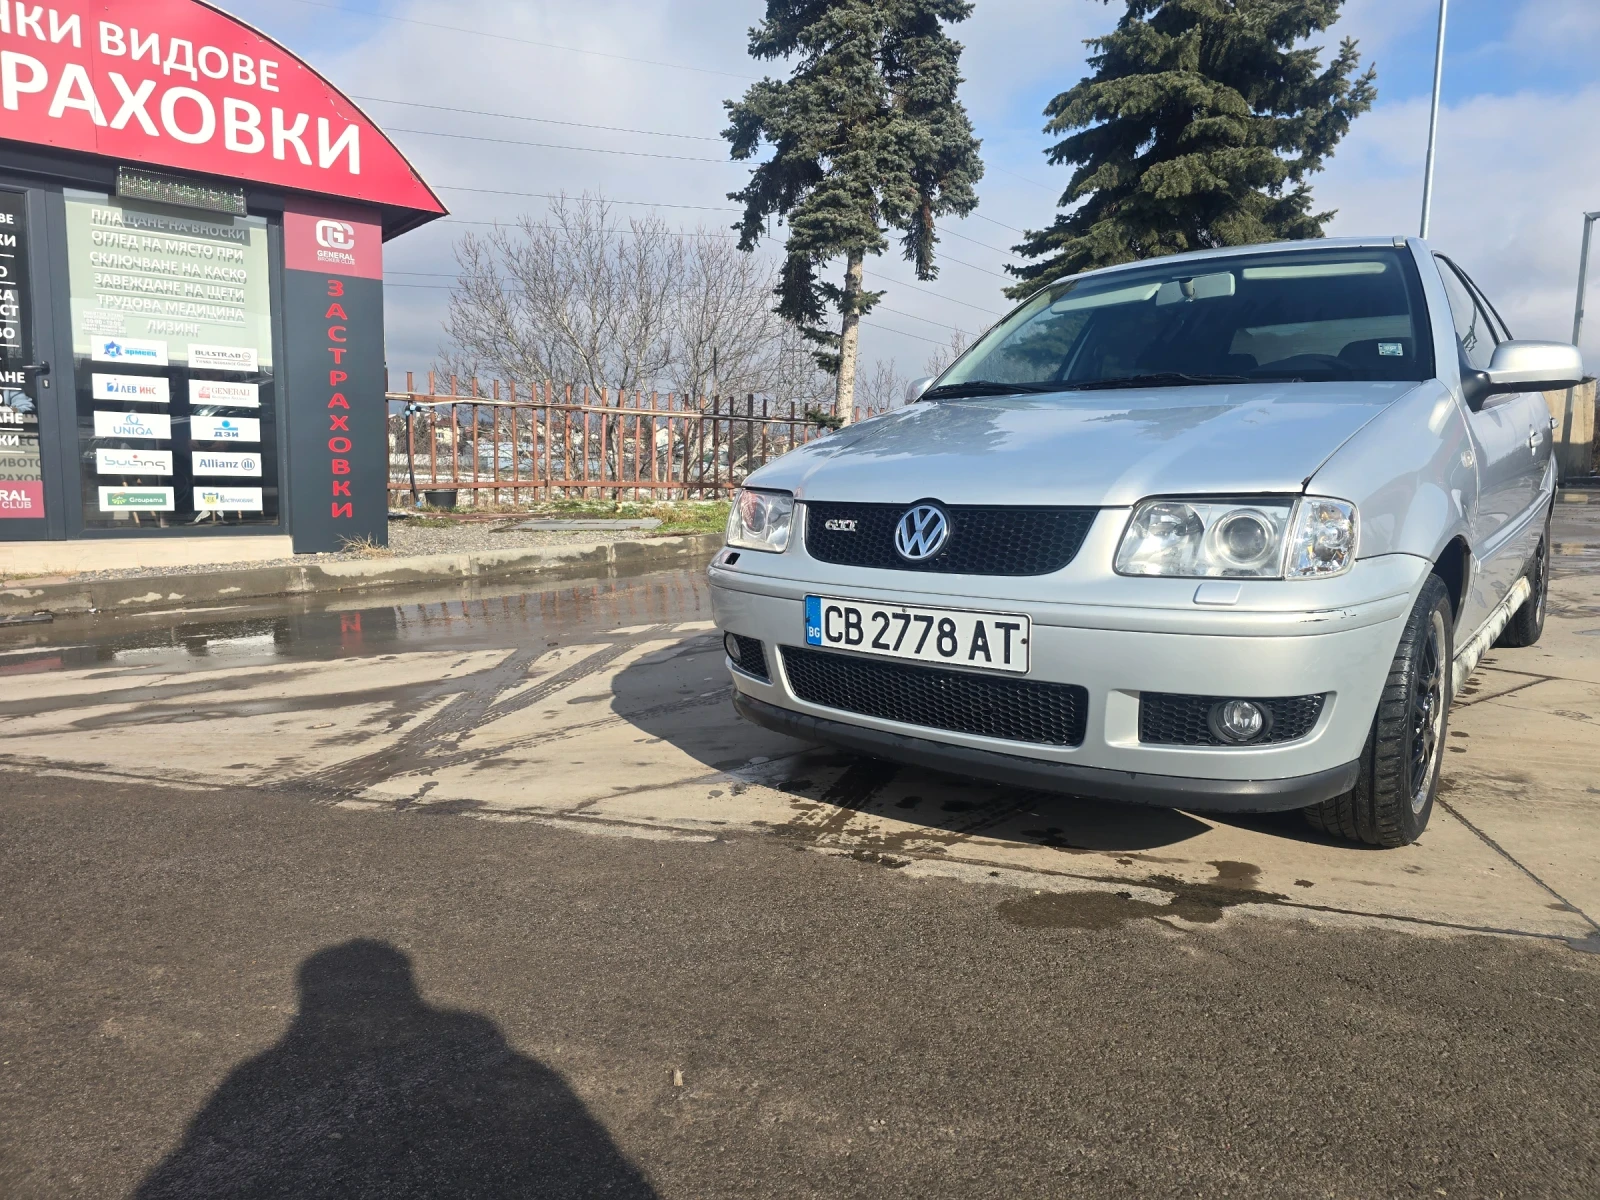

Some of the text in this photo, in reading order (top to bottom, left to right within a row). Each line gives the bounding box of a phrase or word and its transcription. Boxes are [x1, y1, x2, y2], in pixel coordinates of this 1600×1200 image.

[99, 20, 280, 93] ВИДОВЕ
[0, 50, 361, 175] РАХОВКИ
[172, 221, 189, 232] НА
[191, 223, 245, 240] ВНОСКИ
[91, 230, 244, 260] ОГЛЕД НА МЯСТО ПРИ
[317, 250, 355, 261] GENERAL
[89, 251, 247, 280] СКЛЮЧВАНЕ НА КАСКО
[94, 272, 244, 300] ЗАВЕЖДАНЕ НА ЩЕТИ
[96, 294, 245, 319] ТРУДОВА МЕДИЦИНА
[147, 320, 200, 334] ЛИЗИНГ
[195, 350, 241, 359] BULSTRAD
[140, 387, 156, 395] ИНС
[212, 387, 250, 396] GENERALI
[325, 279, 353, 518] ЗАСТРАХОВКИ
[113, 426, 153, 436] UNIQA
[199, 459, 239, 468] Allianz
[2, 501, 32, 509] CLUB
[808, 626, 821, 638] BG
[824, 605, 1021, 665] CB 2778 AT
